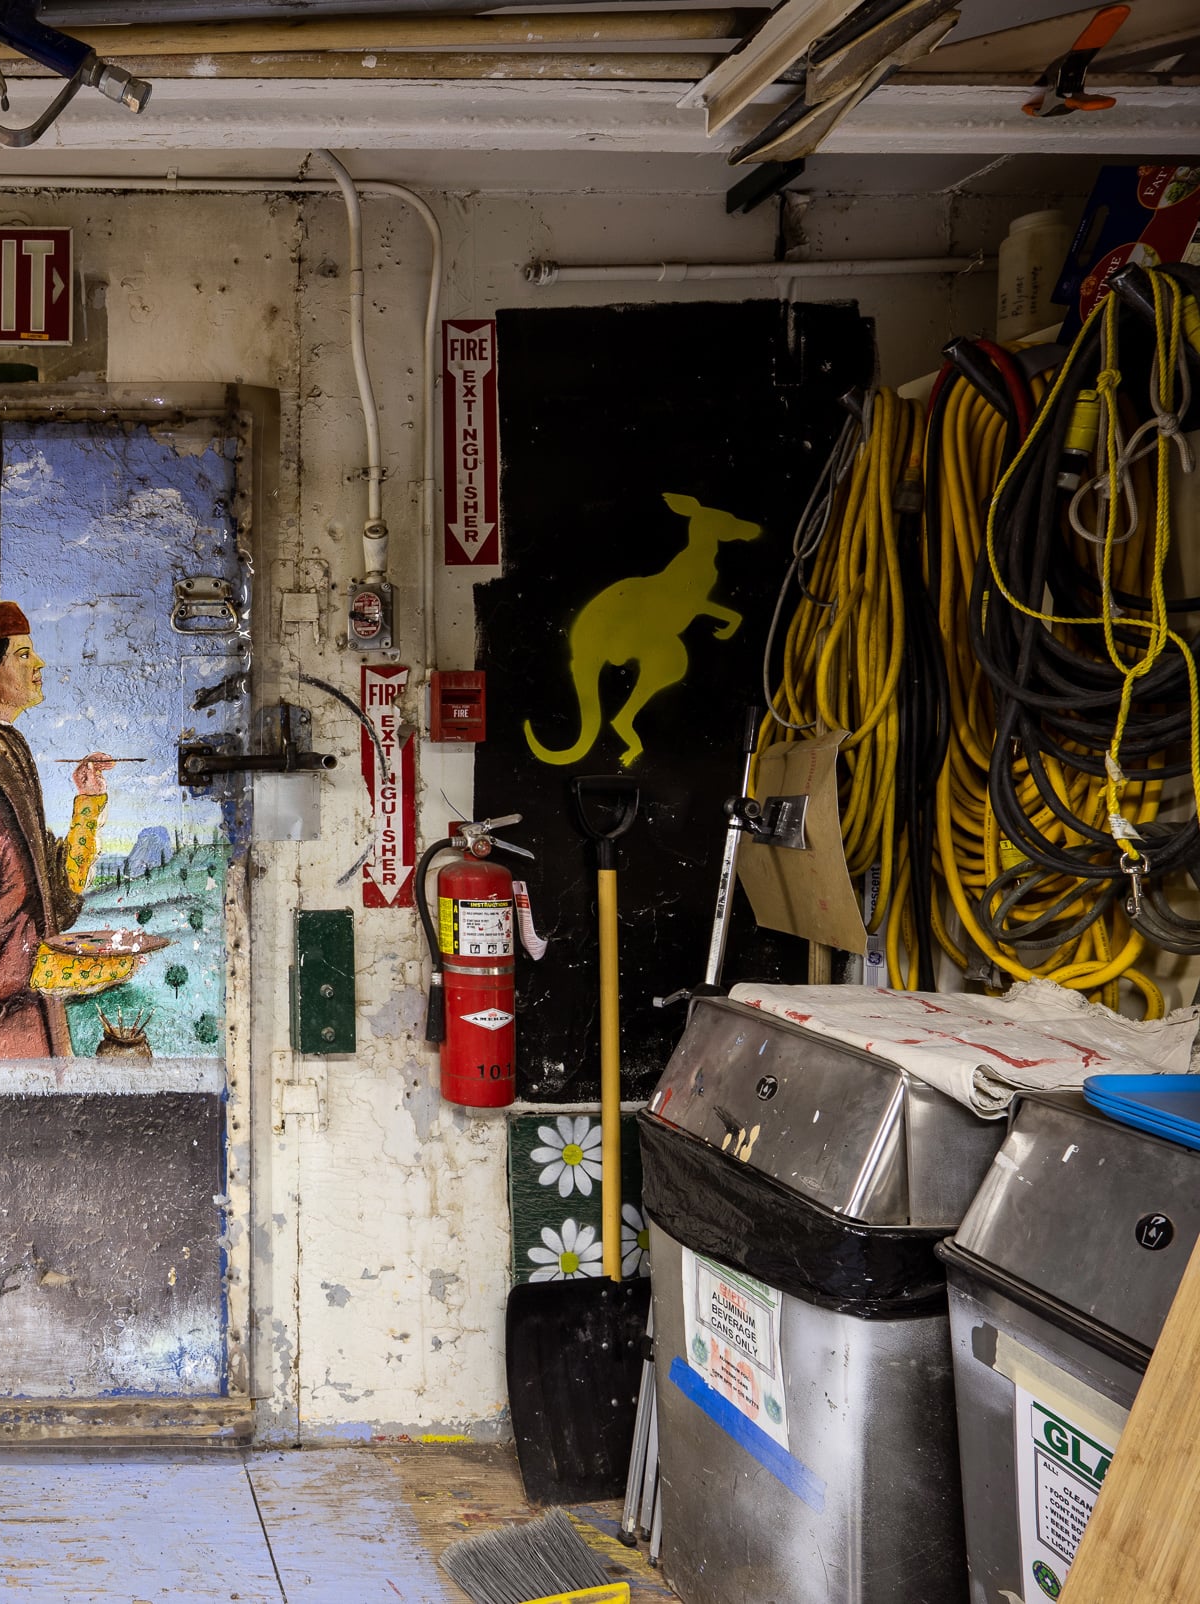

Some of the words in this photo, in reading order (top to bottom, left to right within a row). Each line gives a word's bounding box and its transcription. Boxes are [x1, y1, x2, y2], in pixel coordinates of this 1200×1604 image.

[450, 338, 489, 361] FIRE
[462, 370, 479, 542] EXTINGUISHER
[453, 709, 469, 718] FIRE
[380, 714, 397, 886] EXTNGUISHER
[711, 1291, 756, 1329] ALUMINUM
[711, 1304, 757, 1344] BEVERAGE
[711, 1316, 734, 1340] CANS
[735, 1335, 759, 1360] ONLY
[1049, 1487, 1070, 1507] FOOD
[1071, 1504, 1085, 1518] and
[1063, 1486, 1093, 1513] CLEAN
[1049, 1508, 1070, 1528] WINE
[1071, 1522, 1085, 1537] BO
[1050, 1517, 1070, 1537] BEER
[1050, 1527, 1077, 1551] EMPTY
[1051, 1537, 1074, 1560] LIQUO
